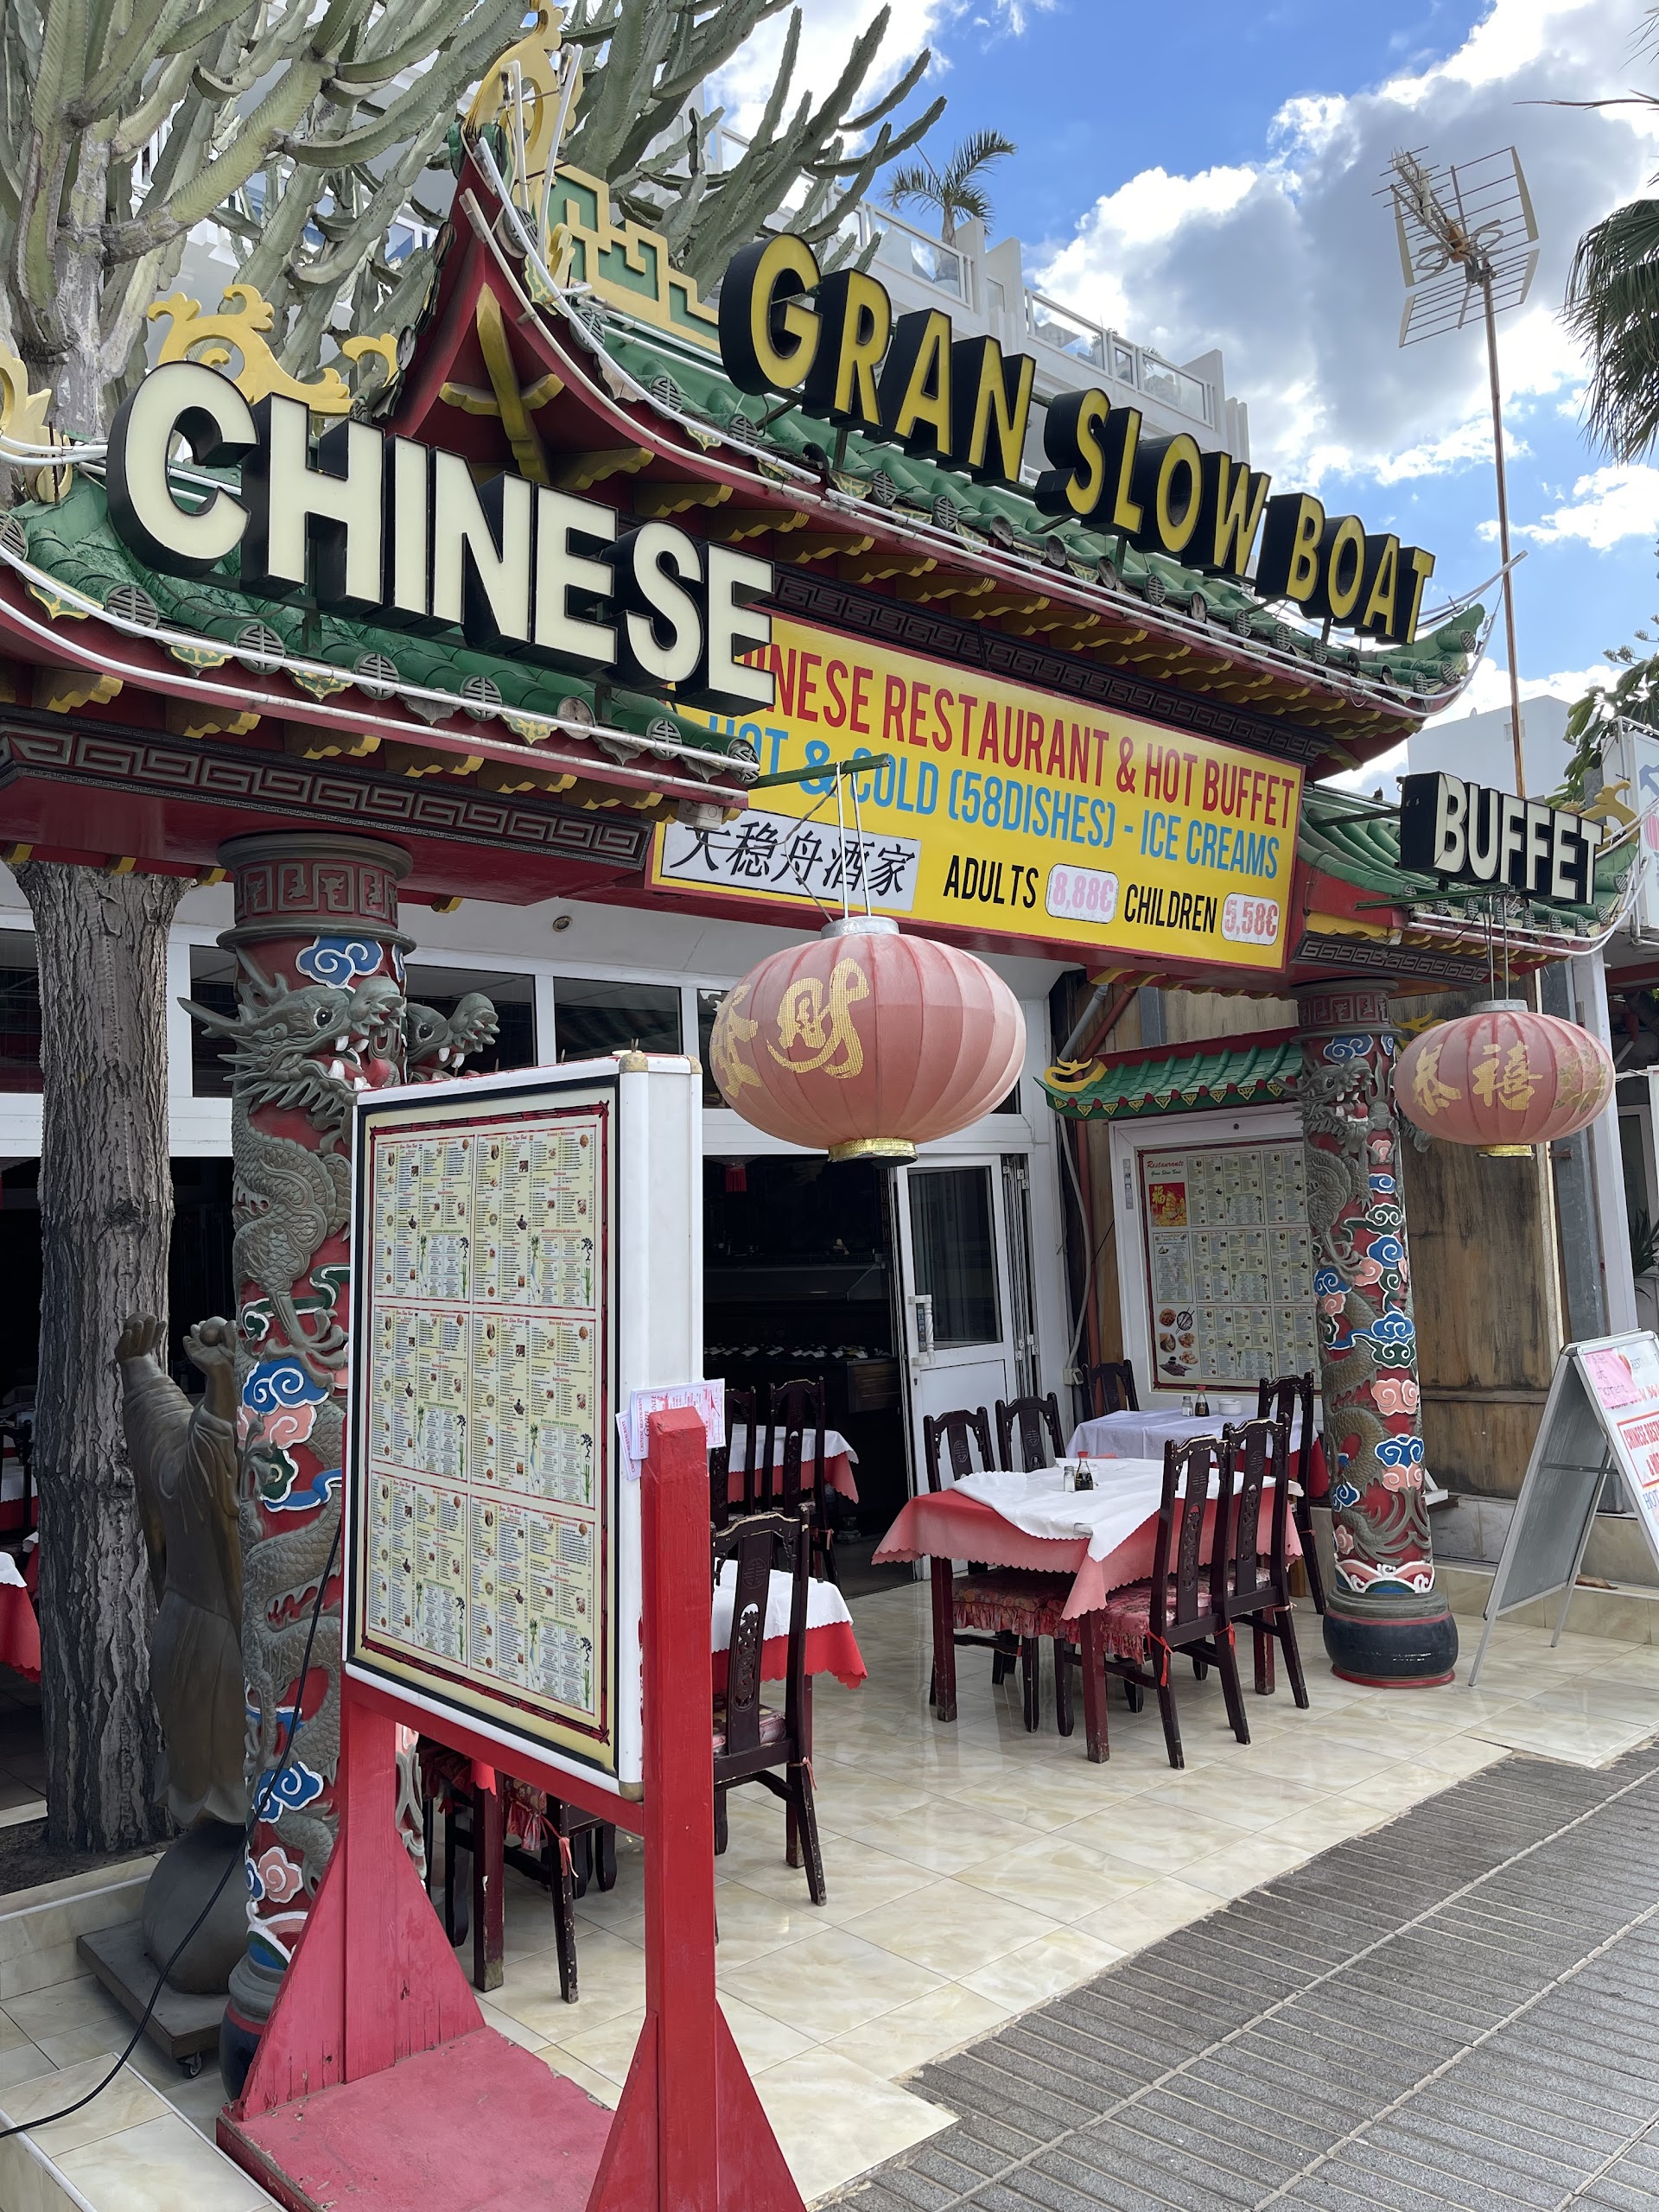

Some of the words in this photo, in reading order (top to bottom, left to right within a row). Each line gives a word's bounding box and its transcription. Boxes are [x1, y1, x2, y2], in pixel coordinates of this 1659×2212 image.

[748, 232, 1037, 484] GRAN
[1061, 388, 1272, 576] SLOW
[1284, 493, 1435, 645] BOAT
[122, 359, 775, 707] CHINESE
[745, 643, 873, 734] NESE
[882, 673, 1109, 787] RESTAURANT
[1116, 736, 1136, 795] &
[1143, 743, 1198, 806] HOT
[1202, 760, 1295, 830] BUFFET
[798, 740, 838, 797] &
[849, 747, 939, 815] COLD
[949, 768, 1117, 849] (58DISHES)
[1140, 809, 1182, 861] ICE
[1185, 819, 1280, 880] CREAMS
[943, 855, 1039, 909] ADULTS
[1052, 871, 1115, 913] 8,88€
[1123, 883, 1218, 934] CHILDREN
[1224, 897, 1280, 938] 5,58€
[1433, 771, 1605, 905] BUFFET
